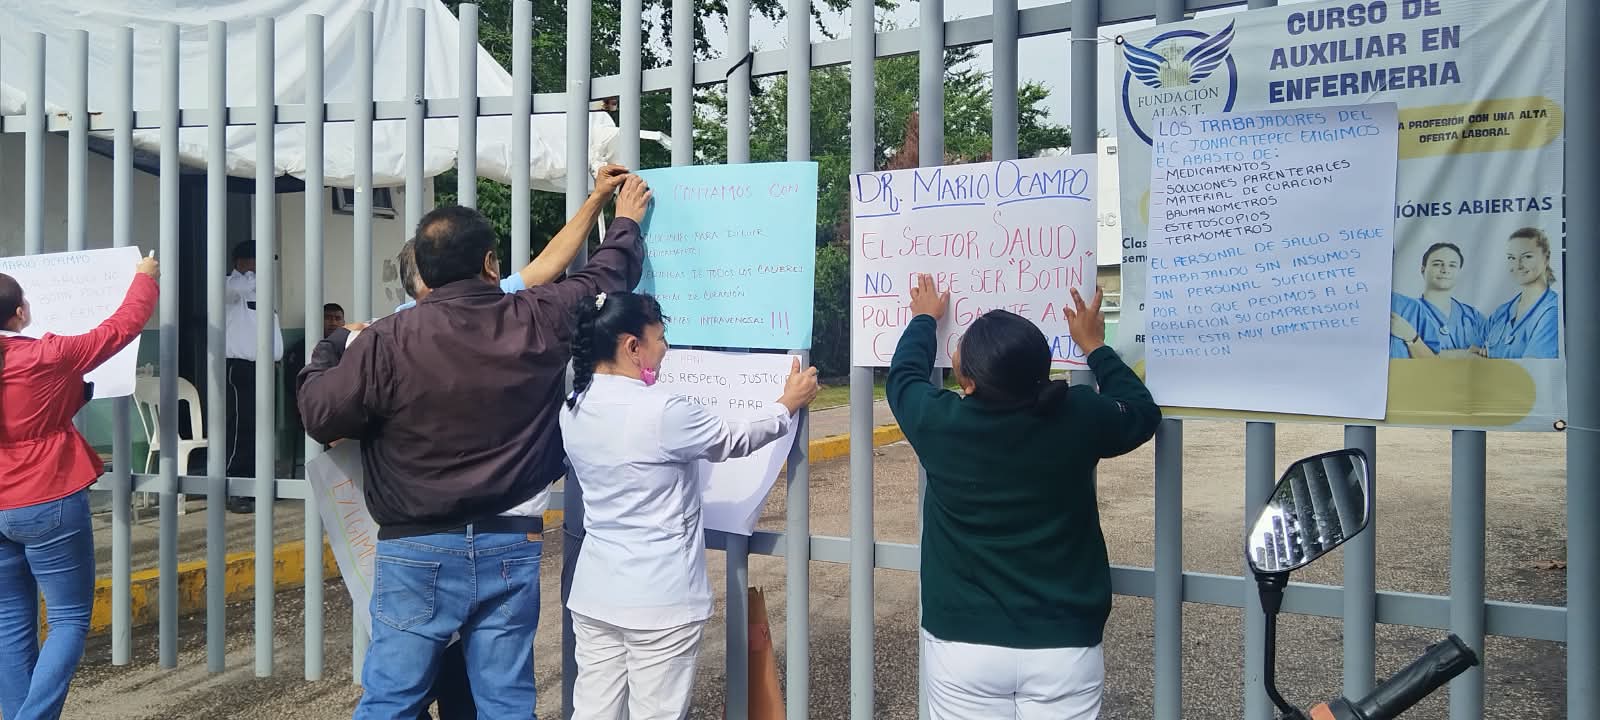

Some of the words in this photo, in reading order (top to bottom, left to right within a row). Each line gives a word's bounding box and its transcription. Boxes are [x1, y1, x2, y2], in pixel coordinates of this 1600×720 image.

[1287, 0, 1387, 35] CURSO
[1402, 0, 1441, 20] DE
[1269, 32, 1406, 70] AUXILIAR
[1422, 25, 1460, 52] EN
[1269, 61, 1461, 103] ENFERMERIA
[1138, 86, 1219, 107] FUNDACIÓN
[1159, 121, 1192, 136] LOS
[1200, 113, 1327, 132] TRABAJADORES
[1338, 110, 1372, 122] DEL
[1468, 113, 1489, 123] CON
[1493, 111, 1515, 121] UNA
[1519, 109, 1547, 119] ALTA
[1189, 132, 1295, 152] JONACATEPEC
[1300, 125, 1380, 143] EXIGIMOS
[1419, 131, 1458, 143] OFERTA
[1462, 128, 1510, 138] LABORAL
[1156, 157, 1176, 168] EL
[1183, 152, 1244, 166] ABASTO
[1243, 160, 1350, 184] PARENTERALES
[913, 168, 990, 203] MARIO
[995, 161, 1088, 198] OCAMPO
[1166, 192, 1232, 206] MATERIAL
[1243, 186, 1258, 195] DE
[1265, 176, 1333, 191] CURACION
[1397, 200, 1452, 218] IÓNES
[1458, 196, 1553, 215] ABIERTAS
[862, 232, 893, 260] EL
[900, 226, 979, 260] SECTOR
[990, 209, 1076, 260] SALUD
[1122, 237, 1147, 249] Clas
[1151, 257, 1168, 269] EL
[1173, 247, 1246, 266] PERSONAL
[1254, 241, 1275, 252] DE
[1281, 233, 1330, 248] SALUD
[1339, 228, 1384, 241] SIGUE
[1152, 266, 1248, 284] TRABAJANDO
[1255, 260, 1281, 272] SIN
[1292, 248, 1361, 267] INSUMOS
[865, 271, 892, 294] NO
[970, 268, 1006, 293] SER
[1152, 289, 1174, 300] SIN
[1187, 280, 1261, 297] PERSONAL
[1272, 267, 1356, 286] SUFICIENTE
[1041, 302, 1057, 322] A
[1153, 306, 1177, 318] POR
[1210, 301, 1241, 313] QUE
[1248, 290, 1317, 308] PEDIMOS
[1326, 286, 1336, 297] A
[1345, 282, 1369, 294] LA
[1151, 316, 1230, 330] POBLACION
[1235, 313, 1251, 323] SU
[1255, 300, 1359, 322] COMPRENSION
[1151, 335, 1185, 344] ANTE
[1198, 332, 1231, 343] ESTA
[1238, 328, 1263, 339] MUY
[1153, 345, 1231, 356] SITUACION
[687, 395, 718, 406] ENCIA
[729, 399, 763, 410] PARA
